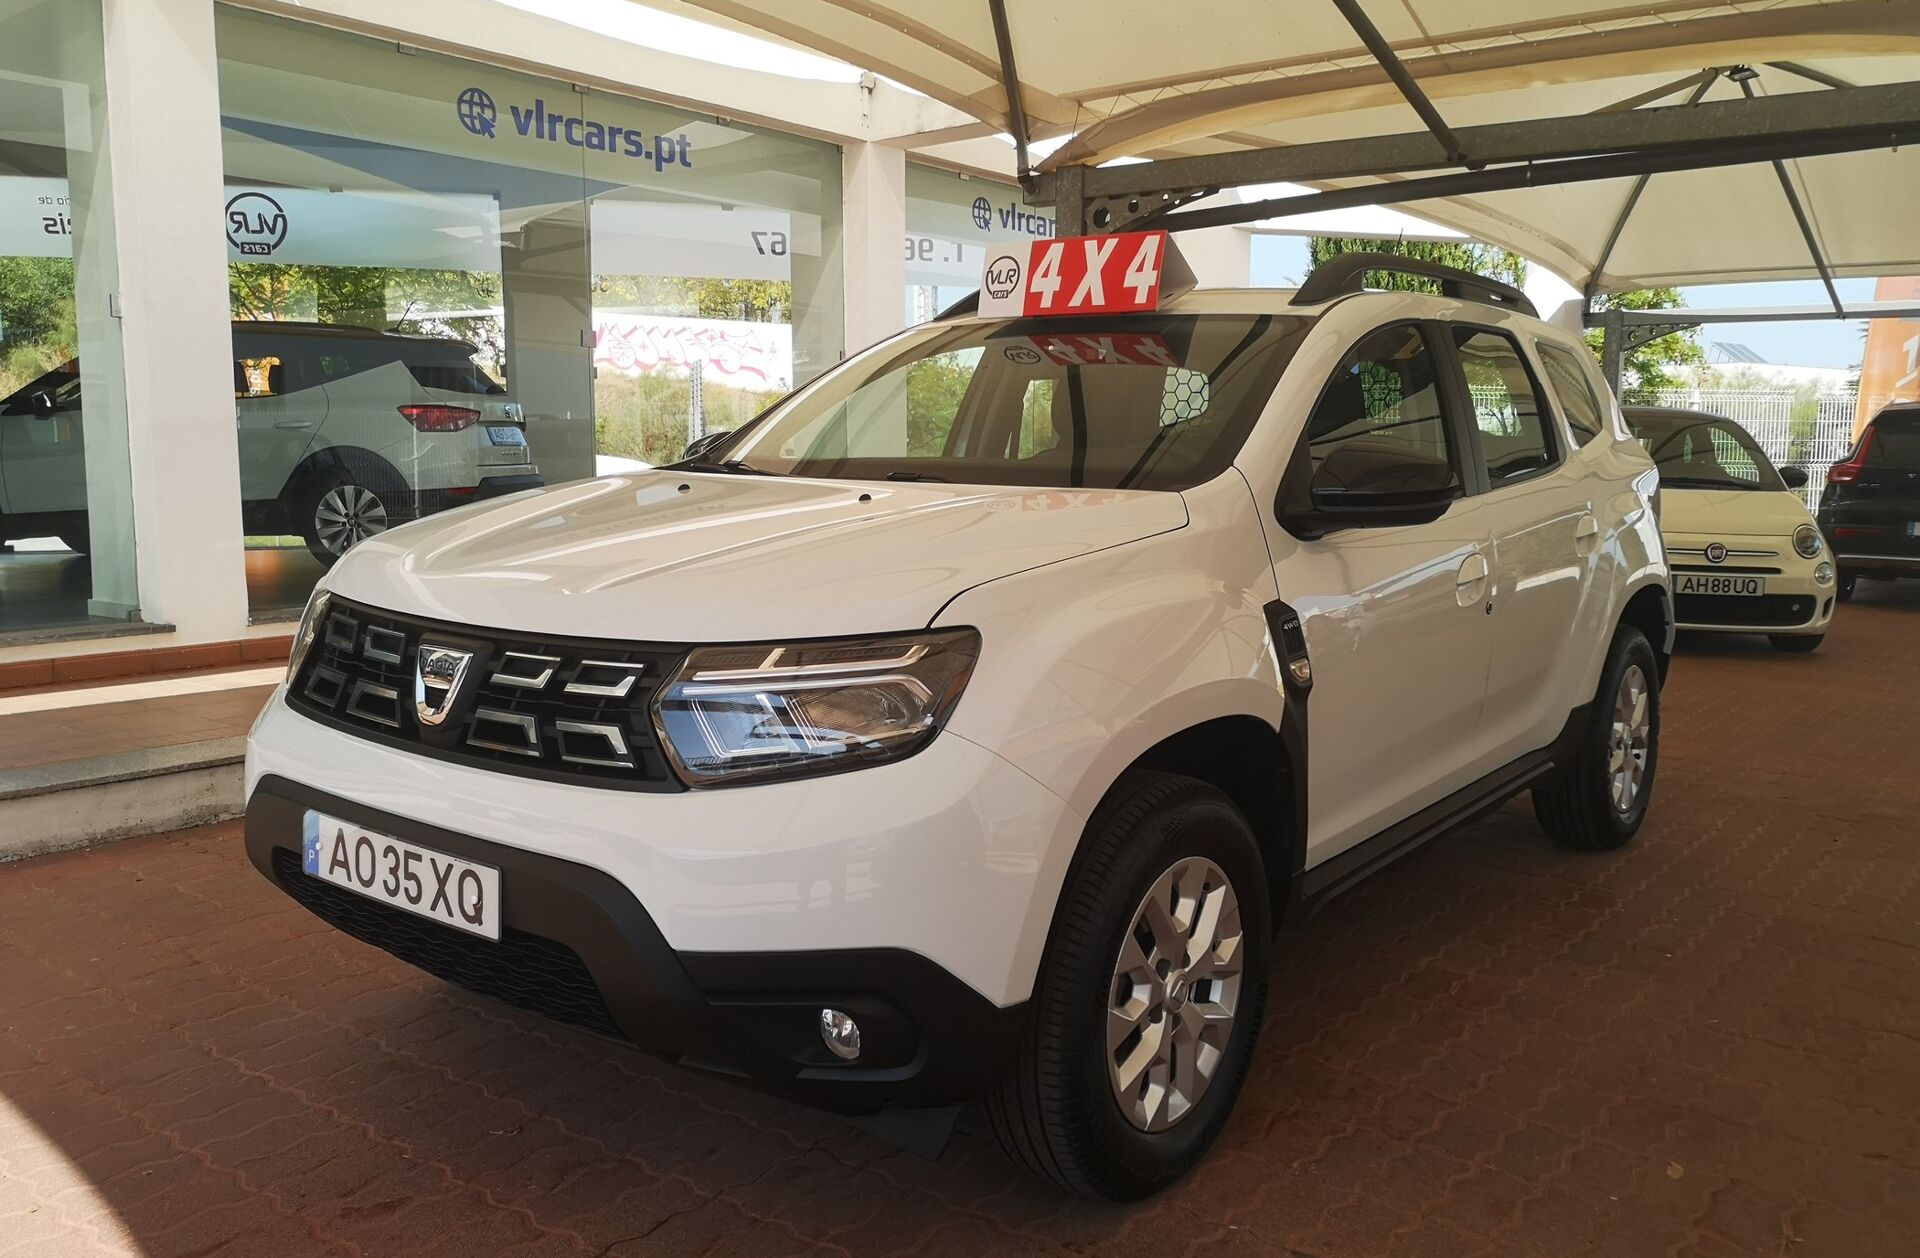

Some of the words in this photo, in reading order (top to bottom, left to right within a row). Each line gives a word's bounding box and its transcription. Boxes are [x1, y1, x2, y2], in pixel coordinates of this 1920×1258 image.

[510, 99, 692, 172] vlrcars.pt
[987, 268, 1017, 285] VLR
[1283, 620, 1299, 630] 4WD
[308, 849, 315, 863] P
